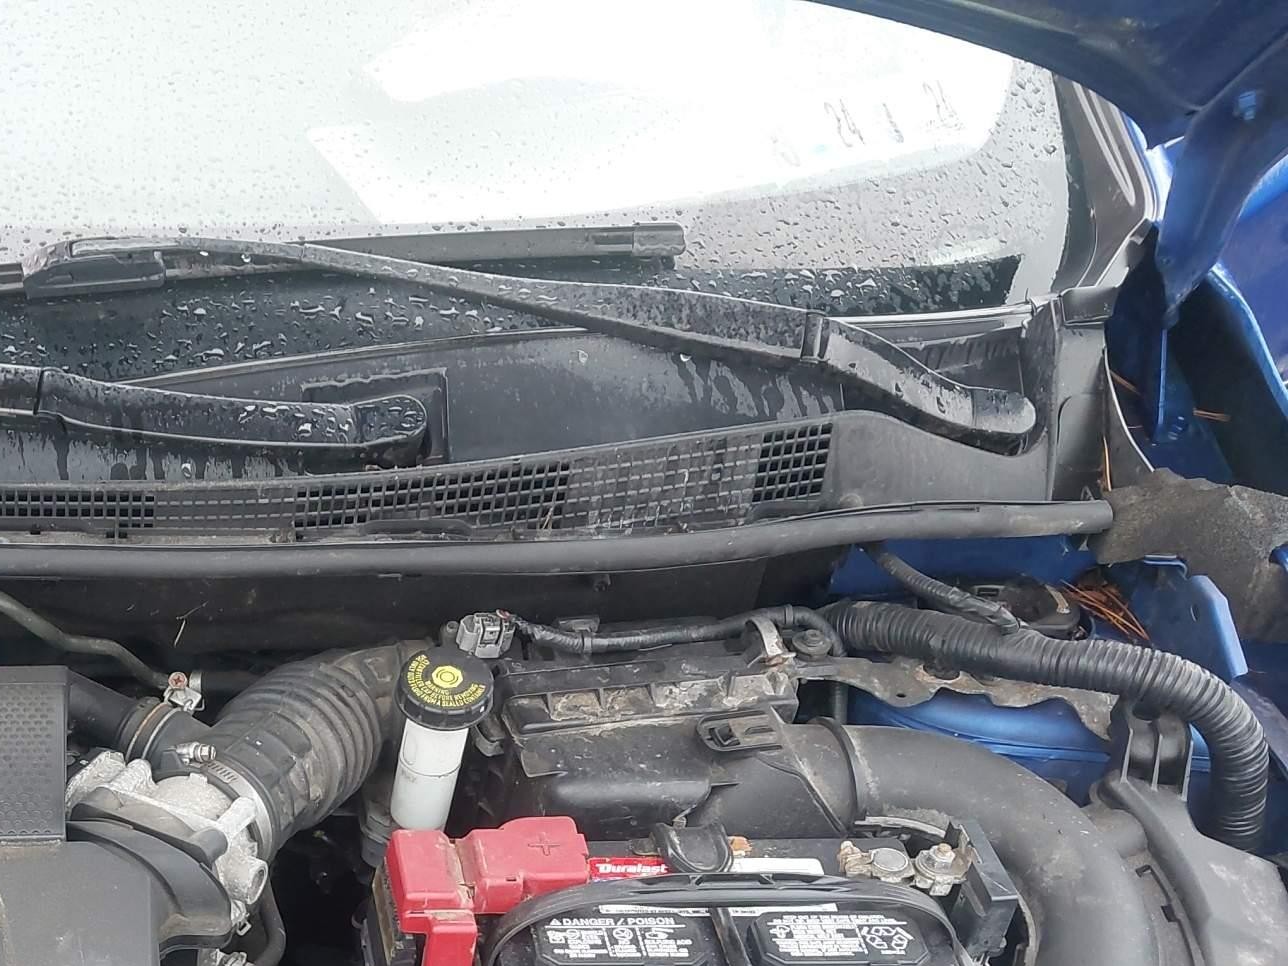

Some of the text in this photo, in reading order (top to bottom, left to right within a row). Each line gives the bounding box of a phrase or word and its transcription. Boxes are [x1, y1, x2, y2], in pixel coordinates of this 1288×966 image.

[595, 863, 669, 874] Duralast
[562, 918, 615, 926] DANGER
[627, 917, 676, 925] POISON
